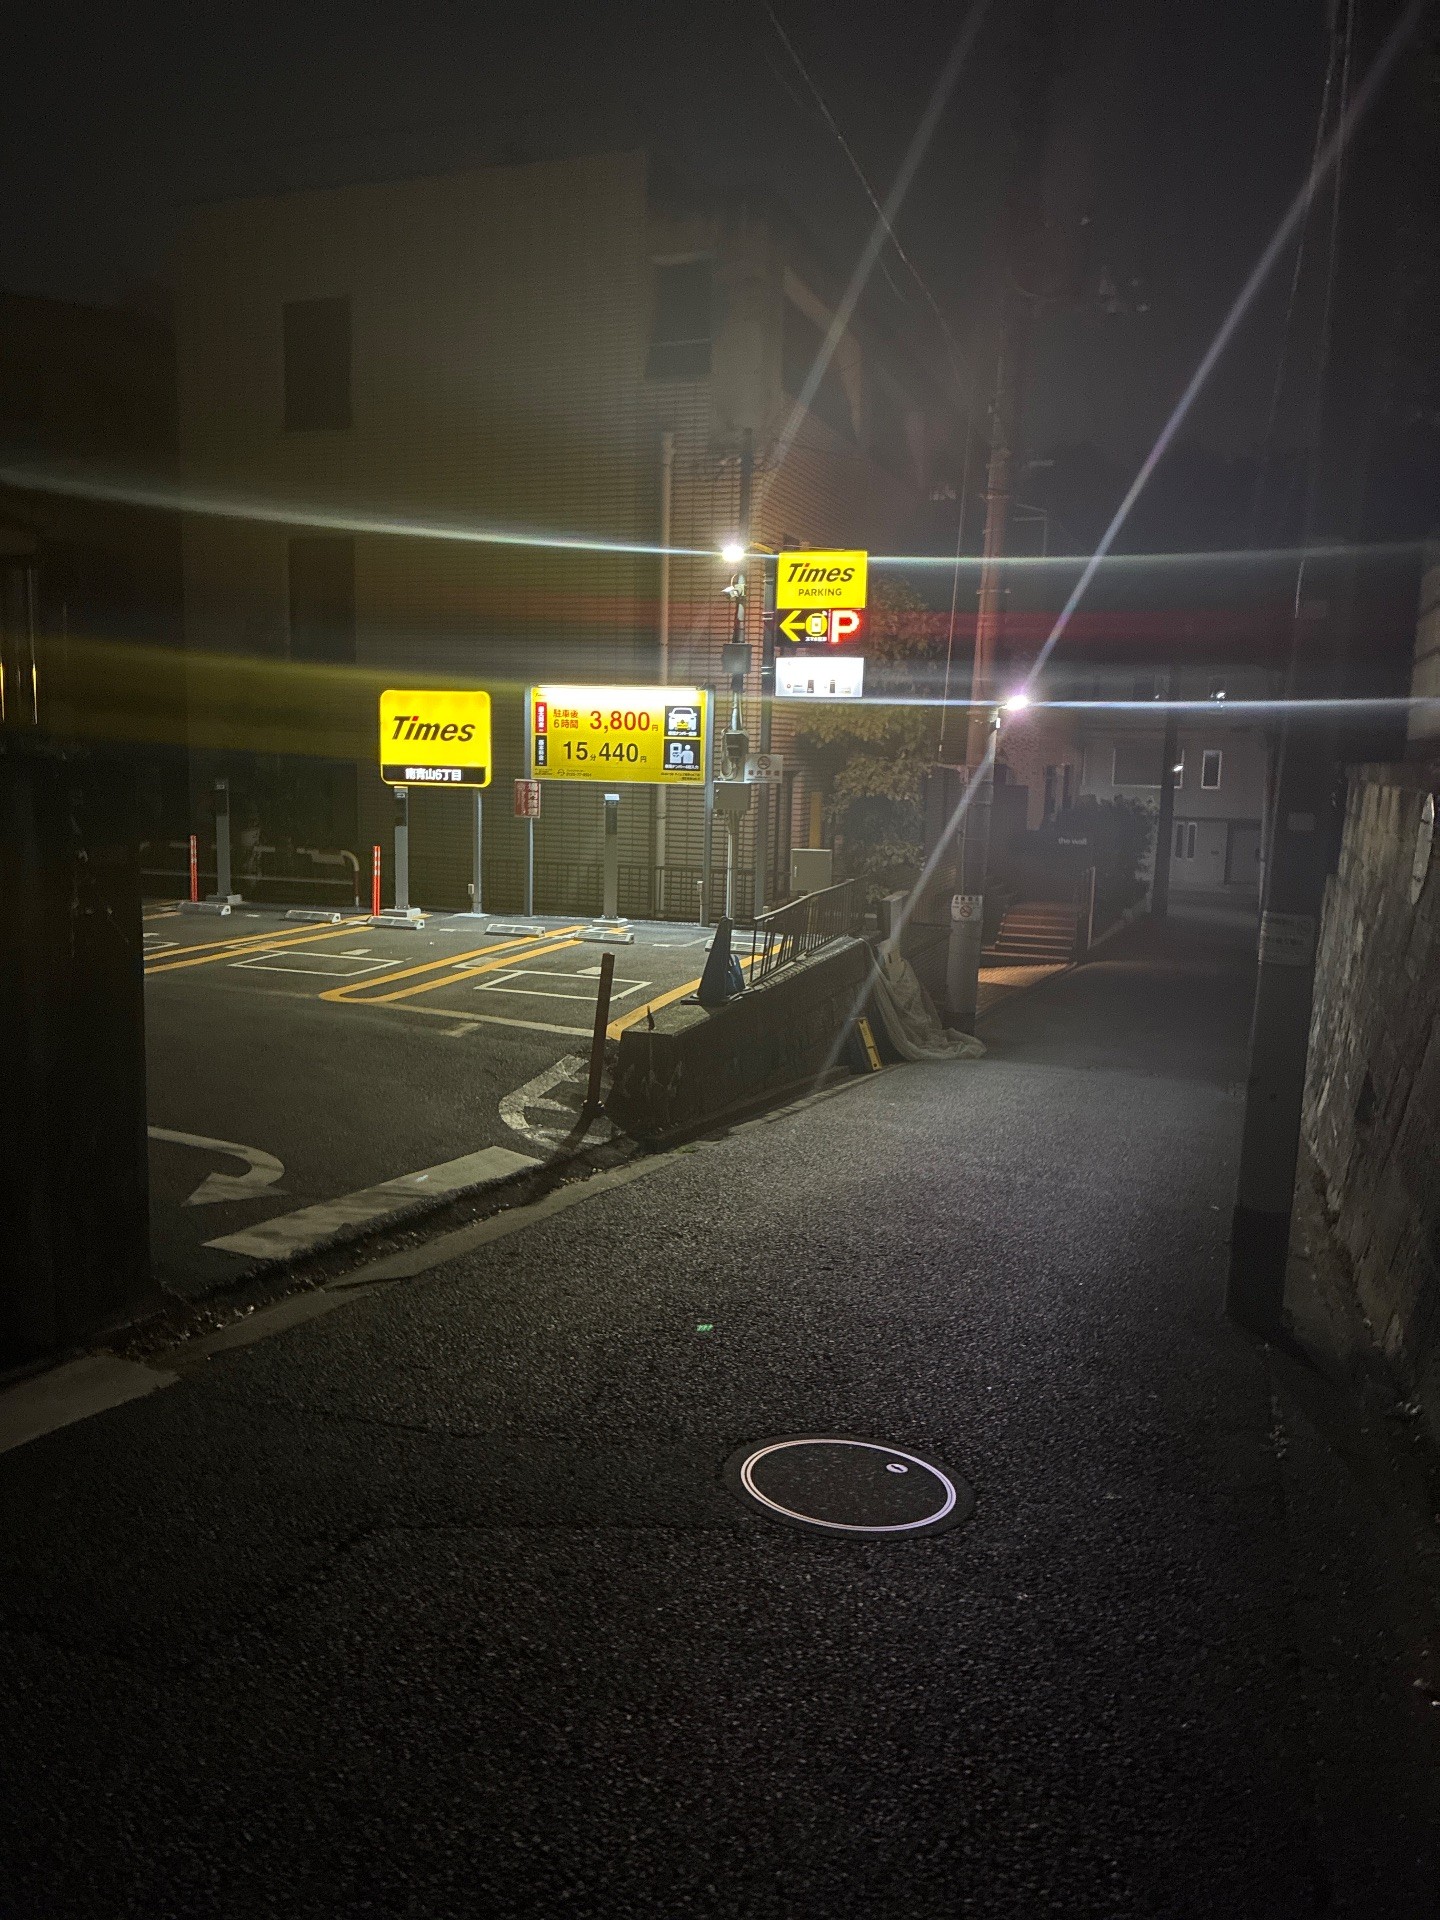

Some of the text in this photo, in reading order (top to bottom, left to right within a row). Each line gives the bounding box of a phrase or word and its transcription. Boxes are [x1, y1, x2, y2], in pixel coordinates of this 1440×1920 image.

[787, 563, 855, 582] Times
[798, 588, 842, 596] PARKING
[831, 609, 860, 643] P
[553, 709, 579, 719] 駐車後
[392, 716, 476, 742] Times
[553, 719, 579, 729] 6時間
